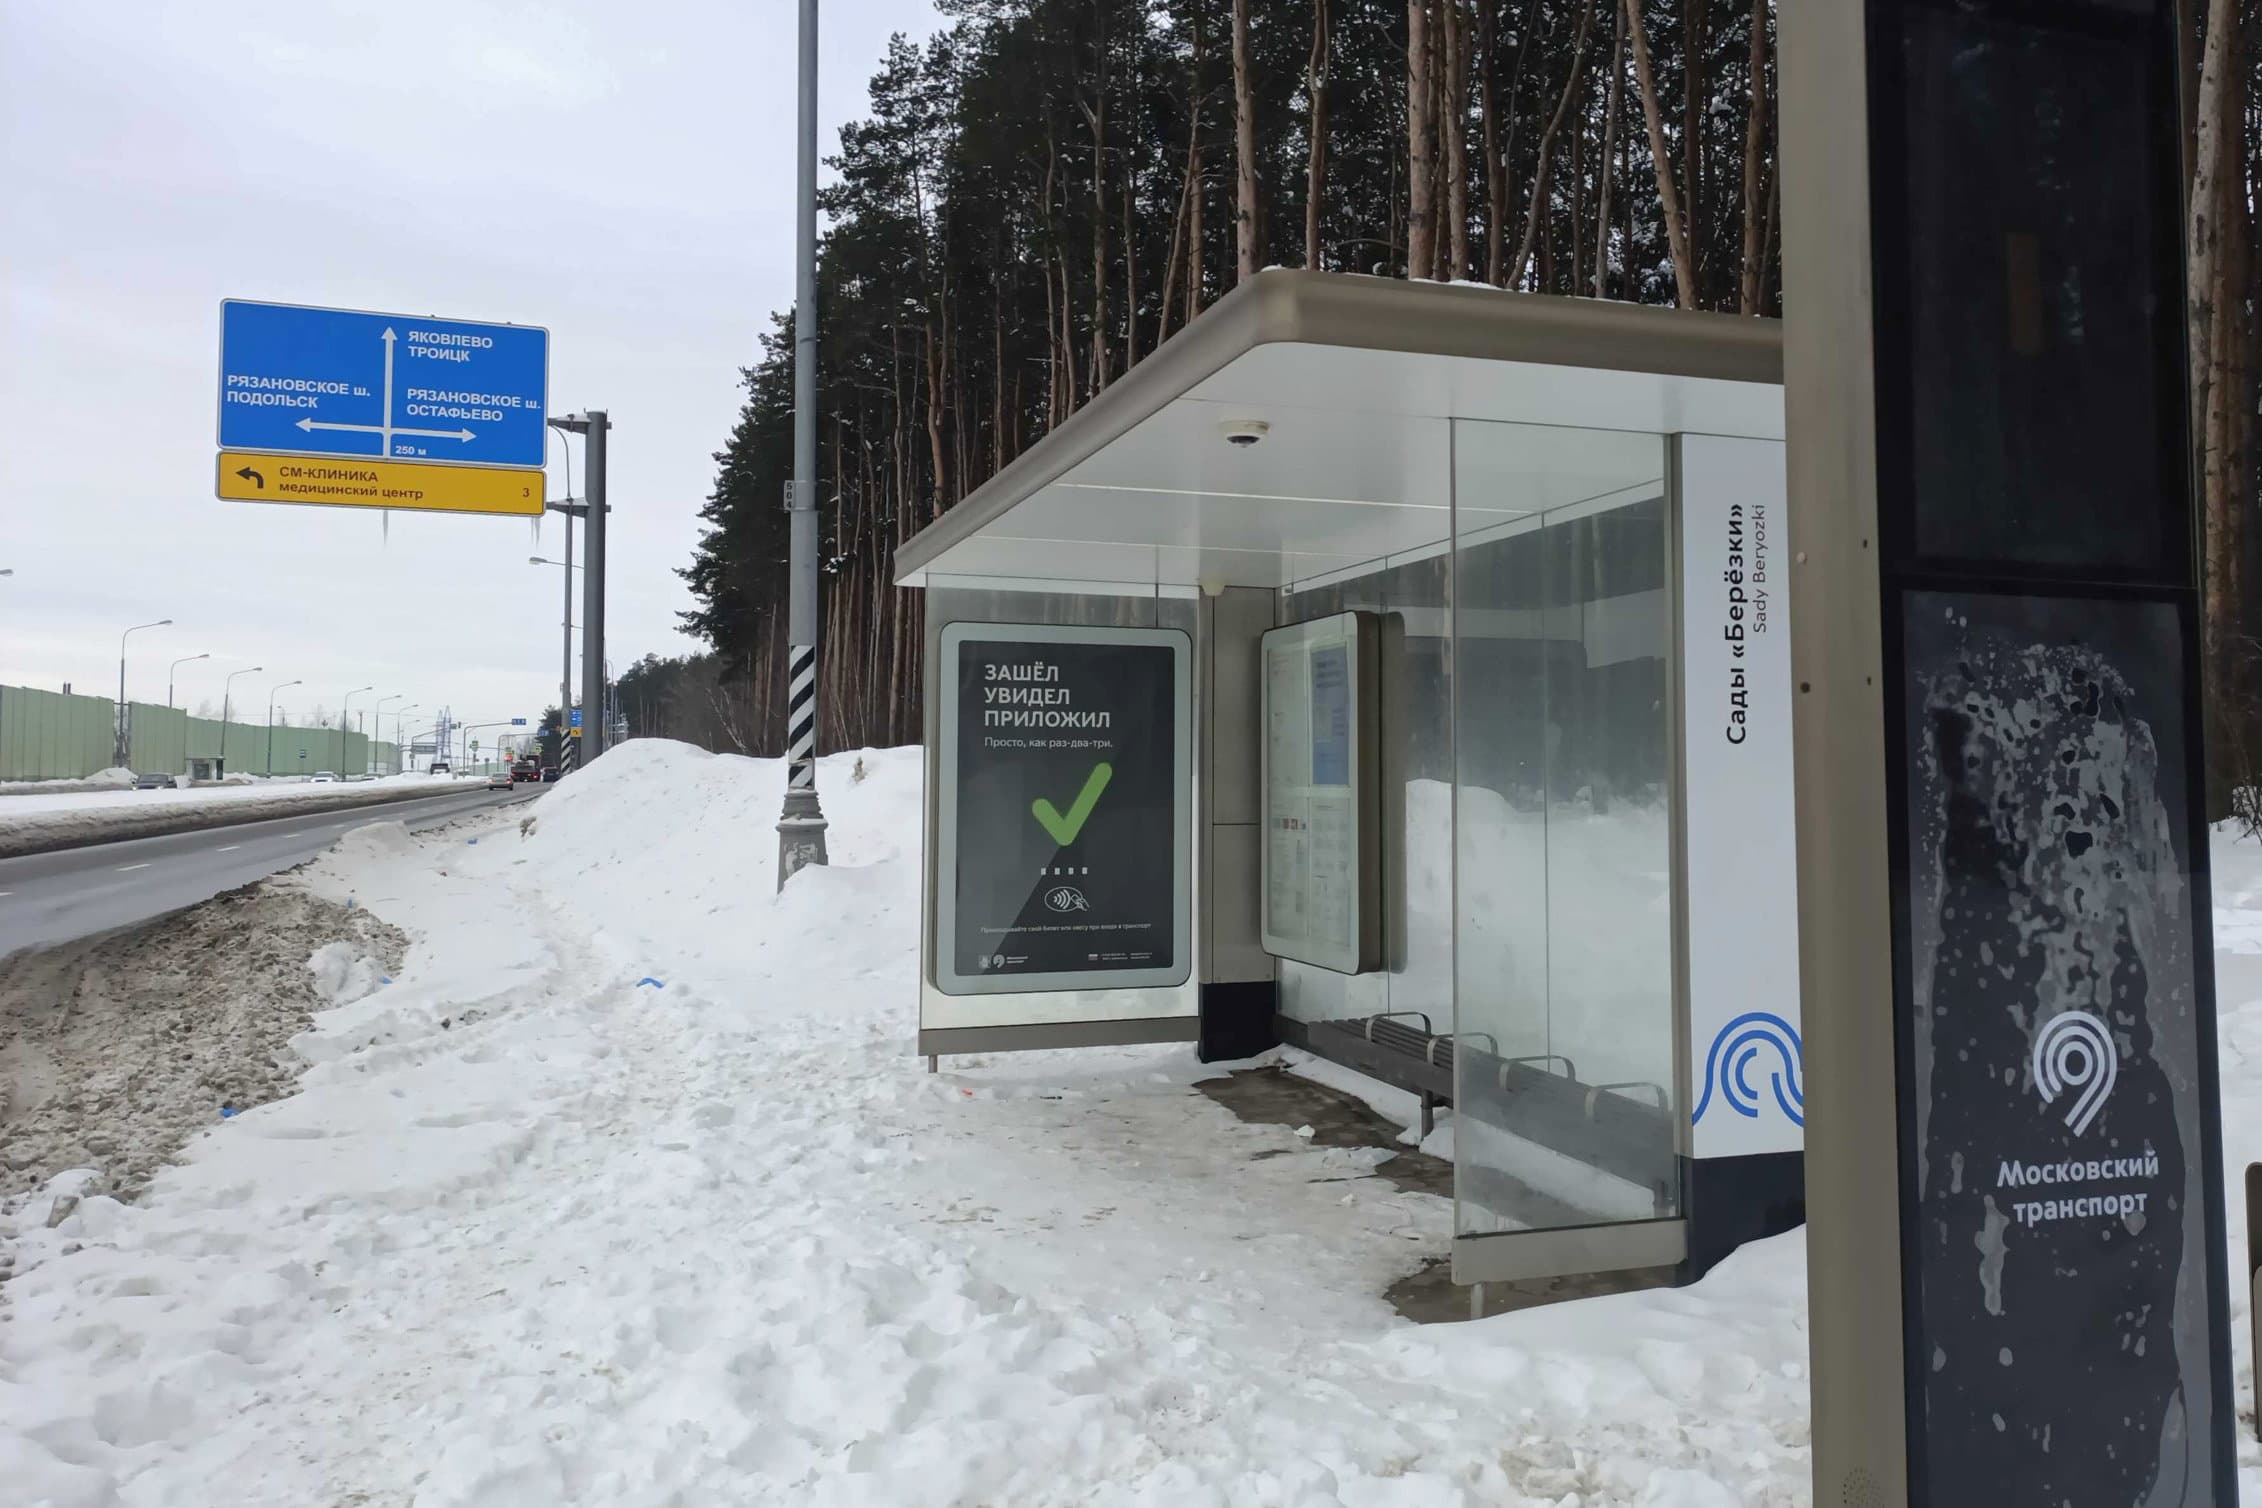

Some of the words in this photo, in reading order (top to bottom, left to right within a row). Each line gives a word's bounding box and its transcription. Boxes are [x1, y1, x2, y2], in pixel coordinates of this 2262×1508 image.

[408, 331, 493, 349] ЯКОВЛЕВО
[408, 346, 470, 362] ТРОИЦК
[227, 375, 349, 395] РЯЗАНОВСКОЕ
[353, 386, 370, 397] ш.
[227, 391, 318, 408] ПОДОЛЬСК
[407, 388, 521, 408] РЯЗАНОВСКОЕ
[525, 399, 541, 409] ш.
[407, 404, 503, 421] ОСТАФЬЕВО
[395, 445, 415, 455] 250
[418, 448, 427, 456] м
[279, 466, 378, 482] СМ-КЛИНИКА
[279, 482, 378, 497] медицинский
[382, 487, 424, 500] центр
[522, 487, 530, 498] 3
[1751, 504, 1768, 583] Beryozki
[1724, 503, 1748, 658] «Берёзки»
[1753, 589, 1768, 633] Sady
[984, 661, 1059, 682] ЗАШЁЛ
[984, 687, 1070, 707] УВИДЕЛ
[1726, 668, 1748, 745] Сады
[984, 710, 1110, 728] ПРИЛОЖИЛ
[984, 736, 1025, 749] Просто,
[1029, 738, 1047, 748] как
[1049, 738, 1113, 751] раз-два-три.
[1997, 1150, 2159, 1187] Московский
[2013, 1193, 2147, 1228] транспорт
